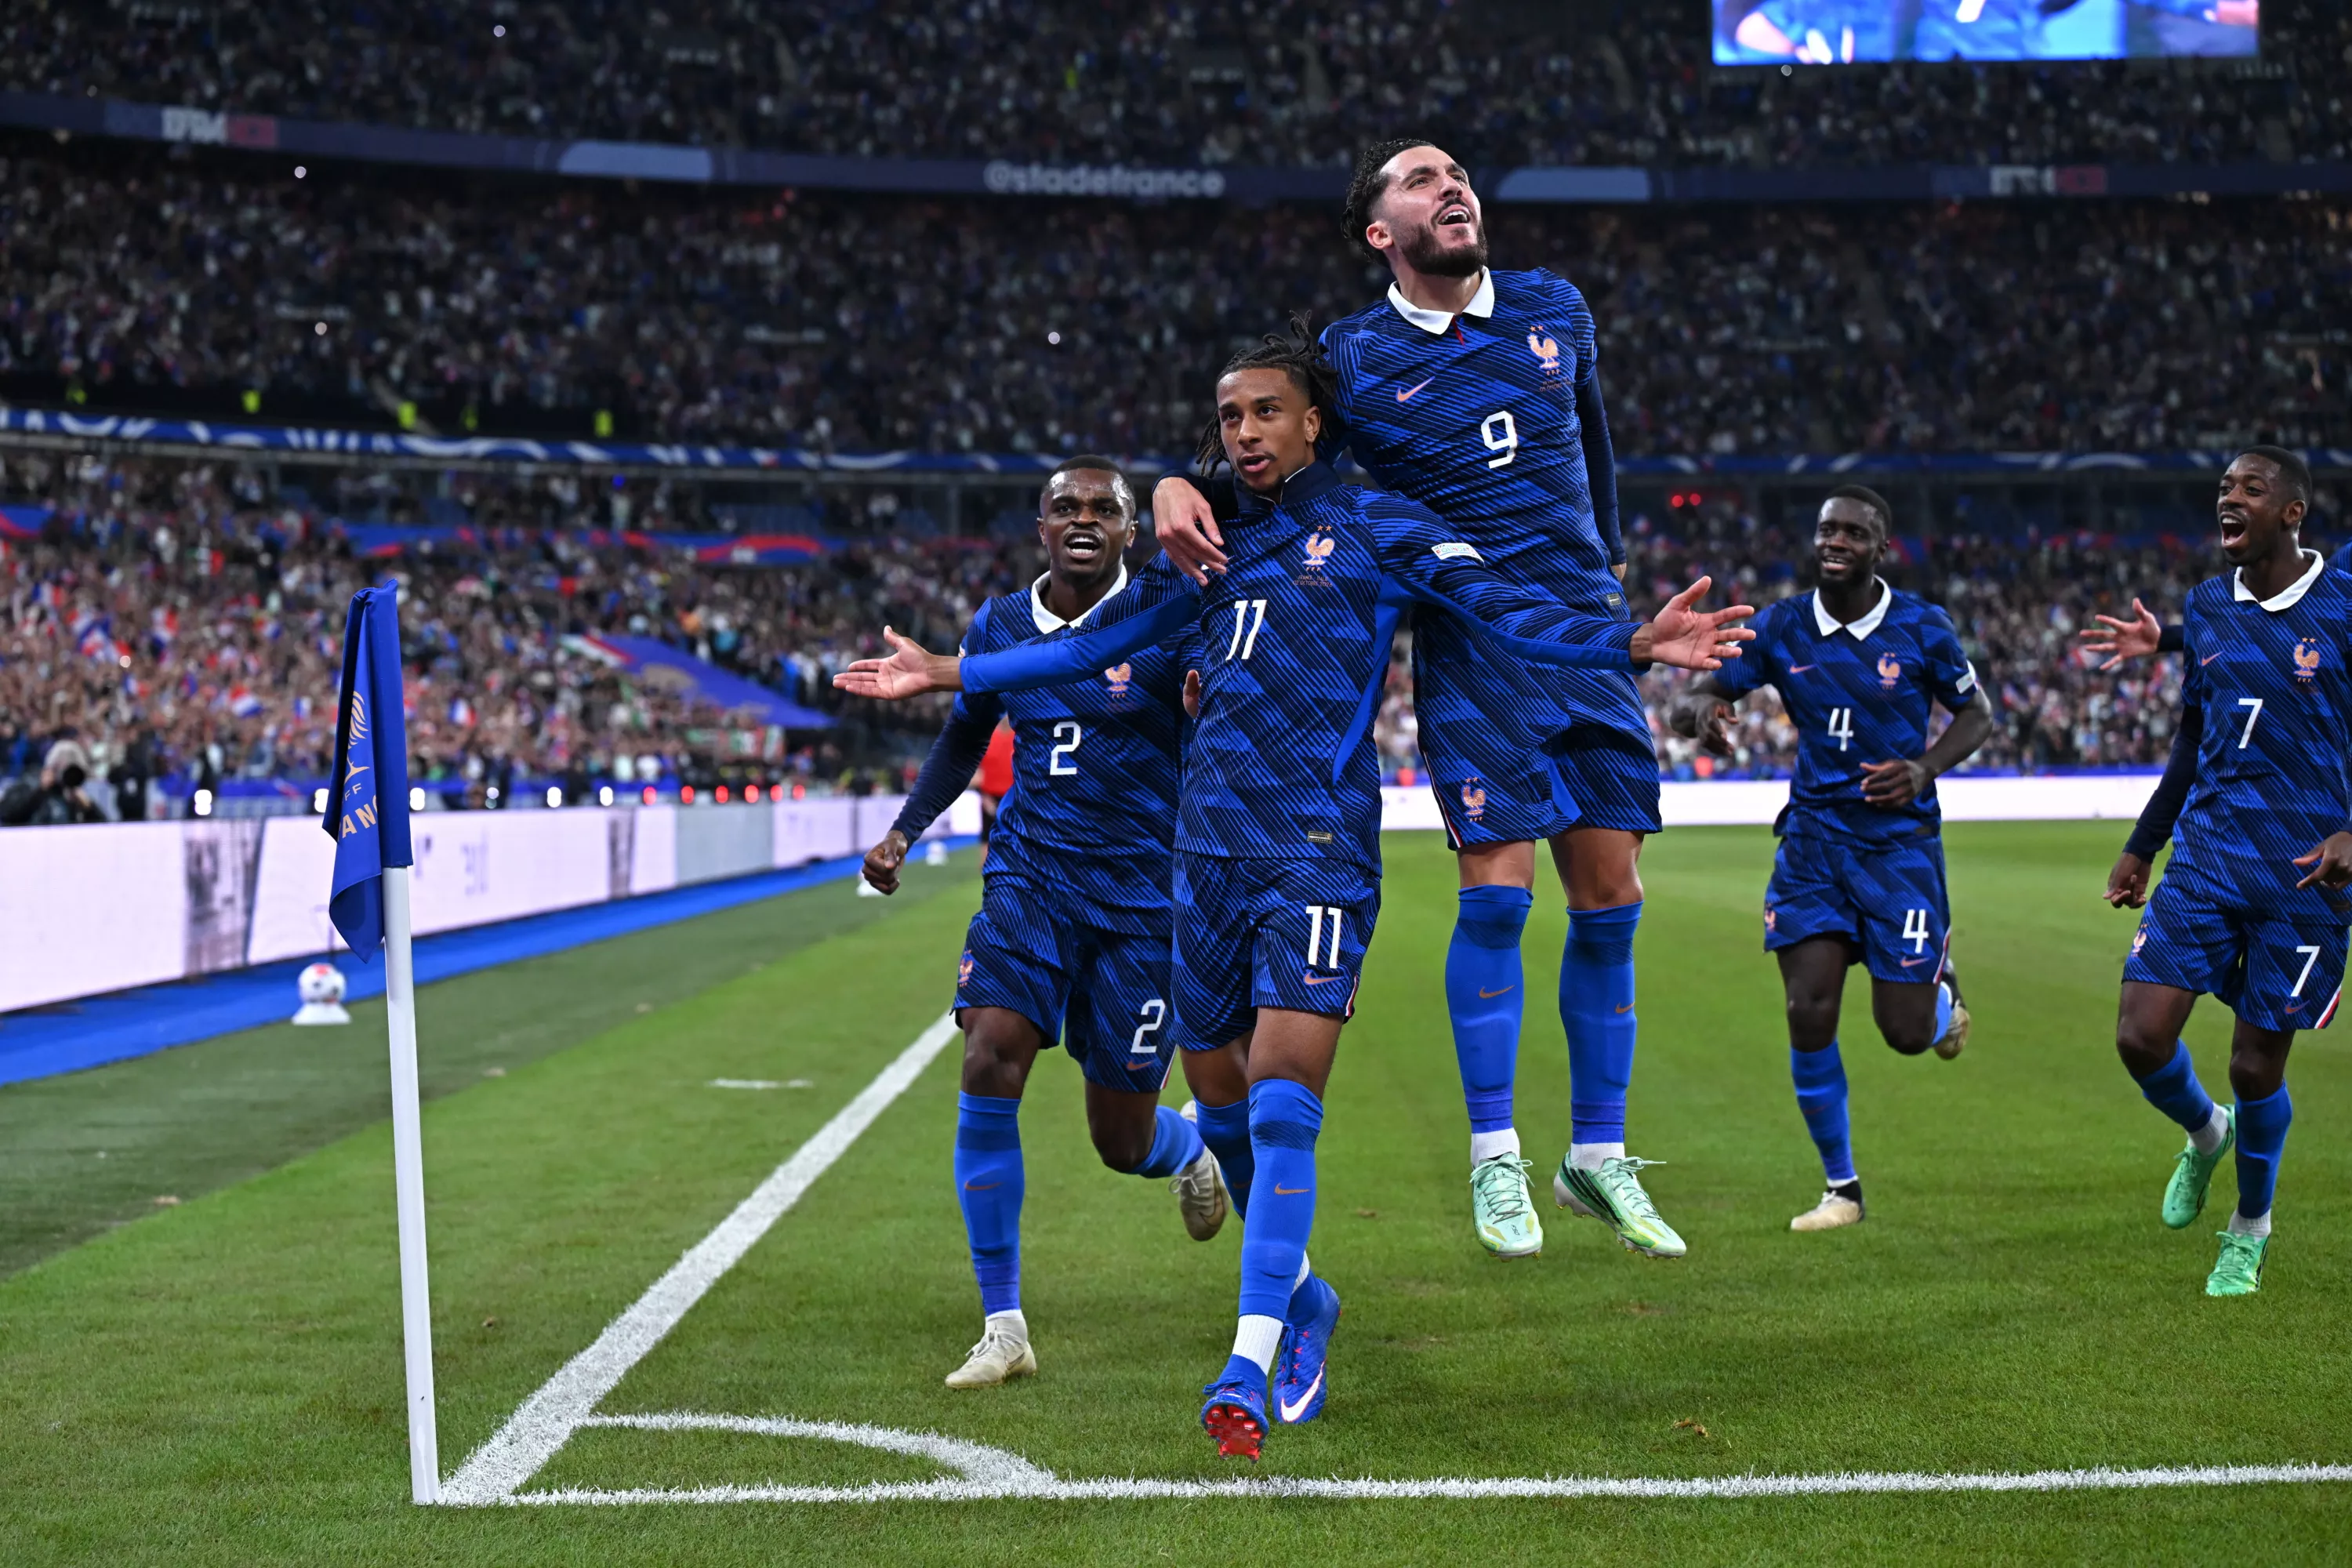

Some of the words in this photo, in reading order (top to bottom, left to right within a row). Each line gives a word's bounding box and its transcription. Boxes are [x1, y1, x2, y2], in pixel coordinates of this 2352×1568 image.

[1481, 410, 1517, 469] 9
[1225, 600, 1267, 660] 11
[1050, 721, 1081, 775] 2
[1828, 708, 1853, 751] 4
[2238, 699, 2263, 749] 7
[1305, 906, 1342, 969] 11
[1902, 909, 1929, 954] 4
[2290, 946, 2320, 996] 7
[1131, 999, 1165, 1053] 2
